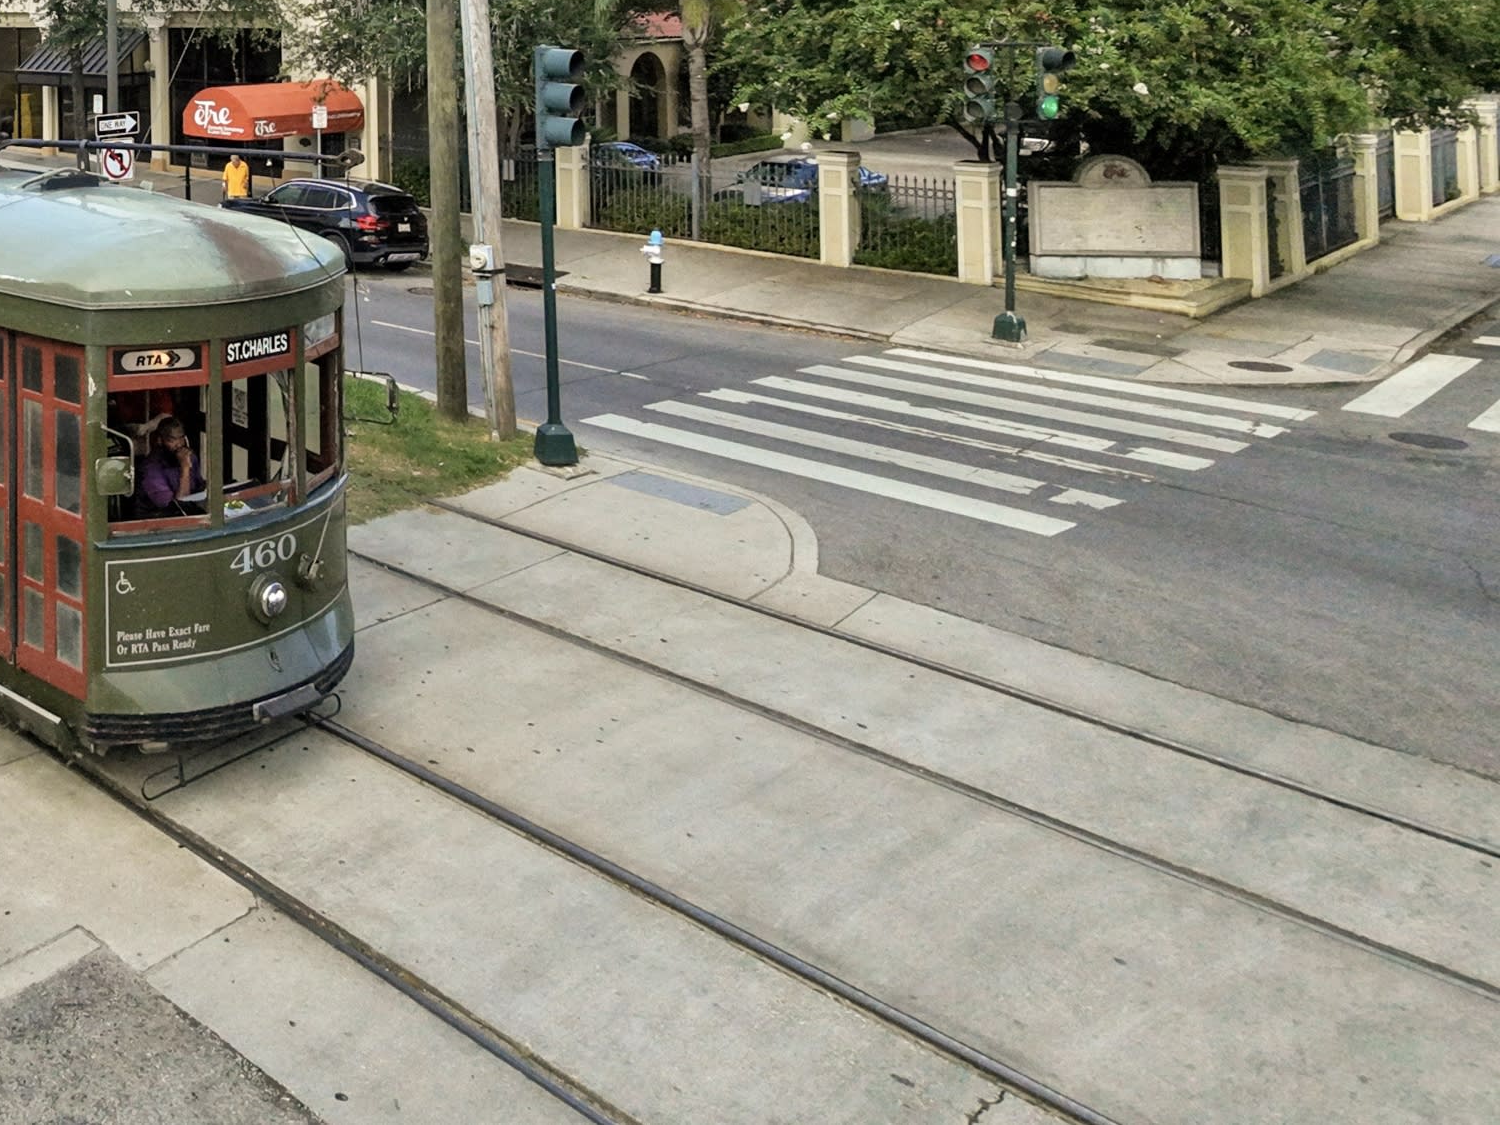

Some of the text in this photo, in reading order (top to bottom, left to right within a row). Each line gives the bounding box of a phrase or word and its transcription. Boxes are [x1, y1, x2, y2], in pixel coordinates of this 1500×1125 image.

[100, 119, 125, 130] ONE WAY
[136, 355, 163, 367] RTA
[230, 533, 297, 575] 460
[116, 623, 210, 642] Please Have Exact Fare
[116, 638, 196, 655] Or RTA Pass Ready
